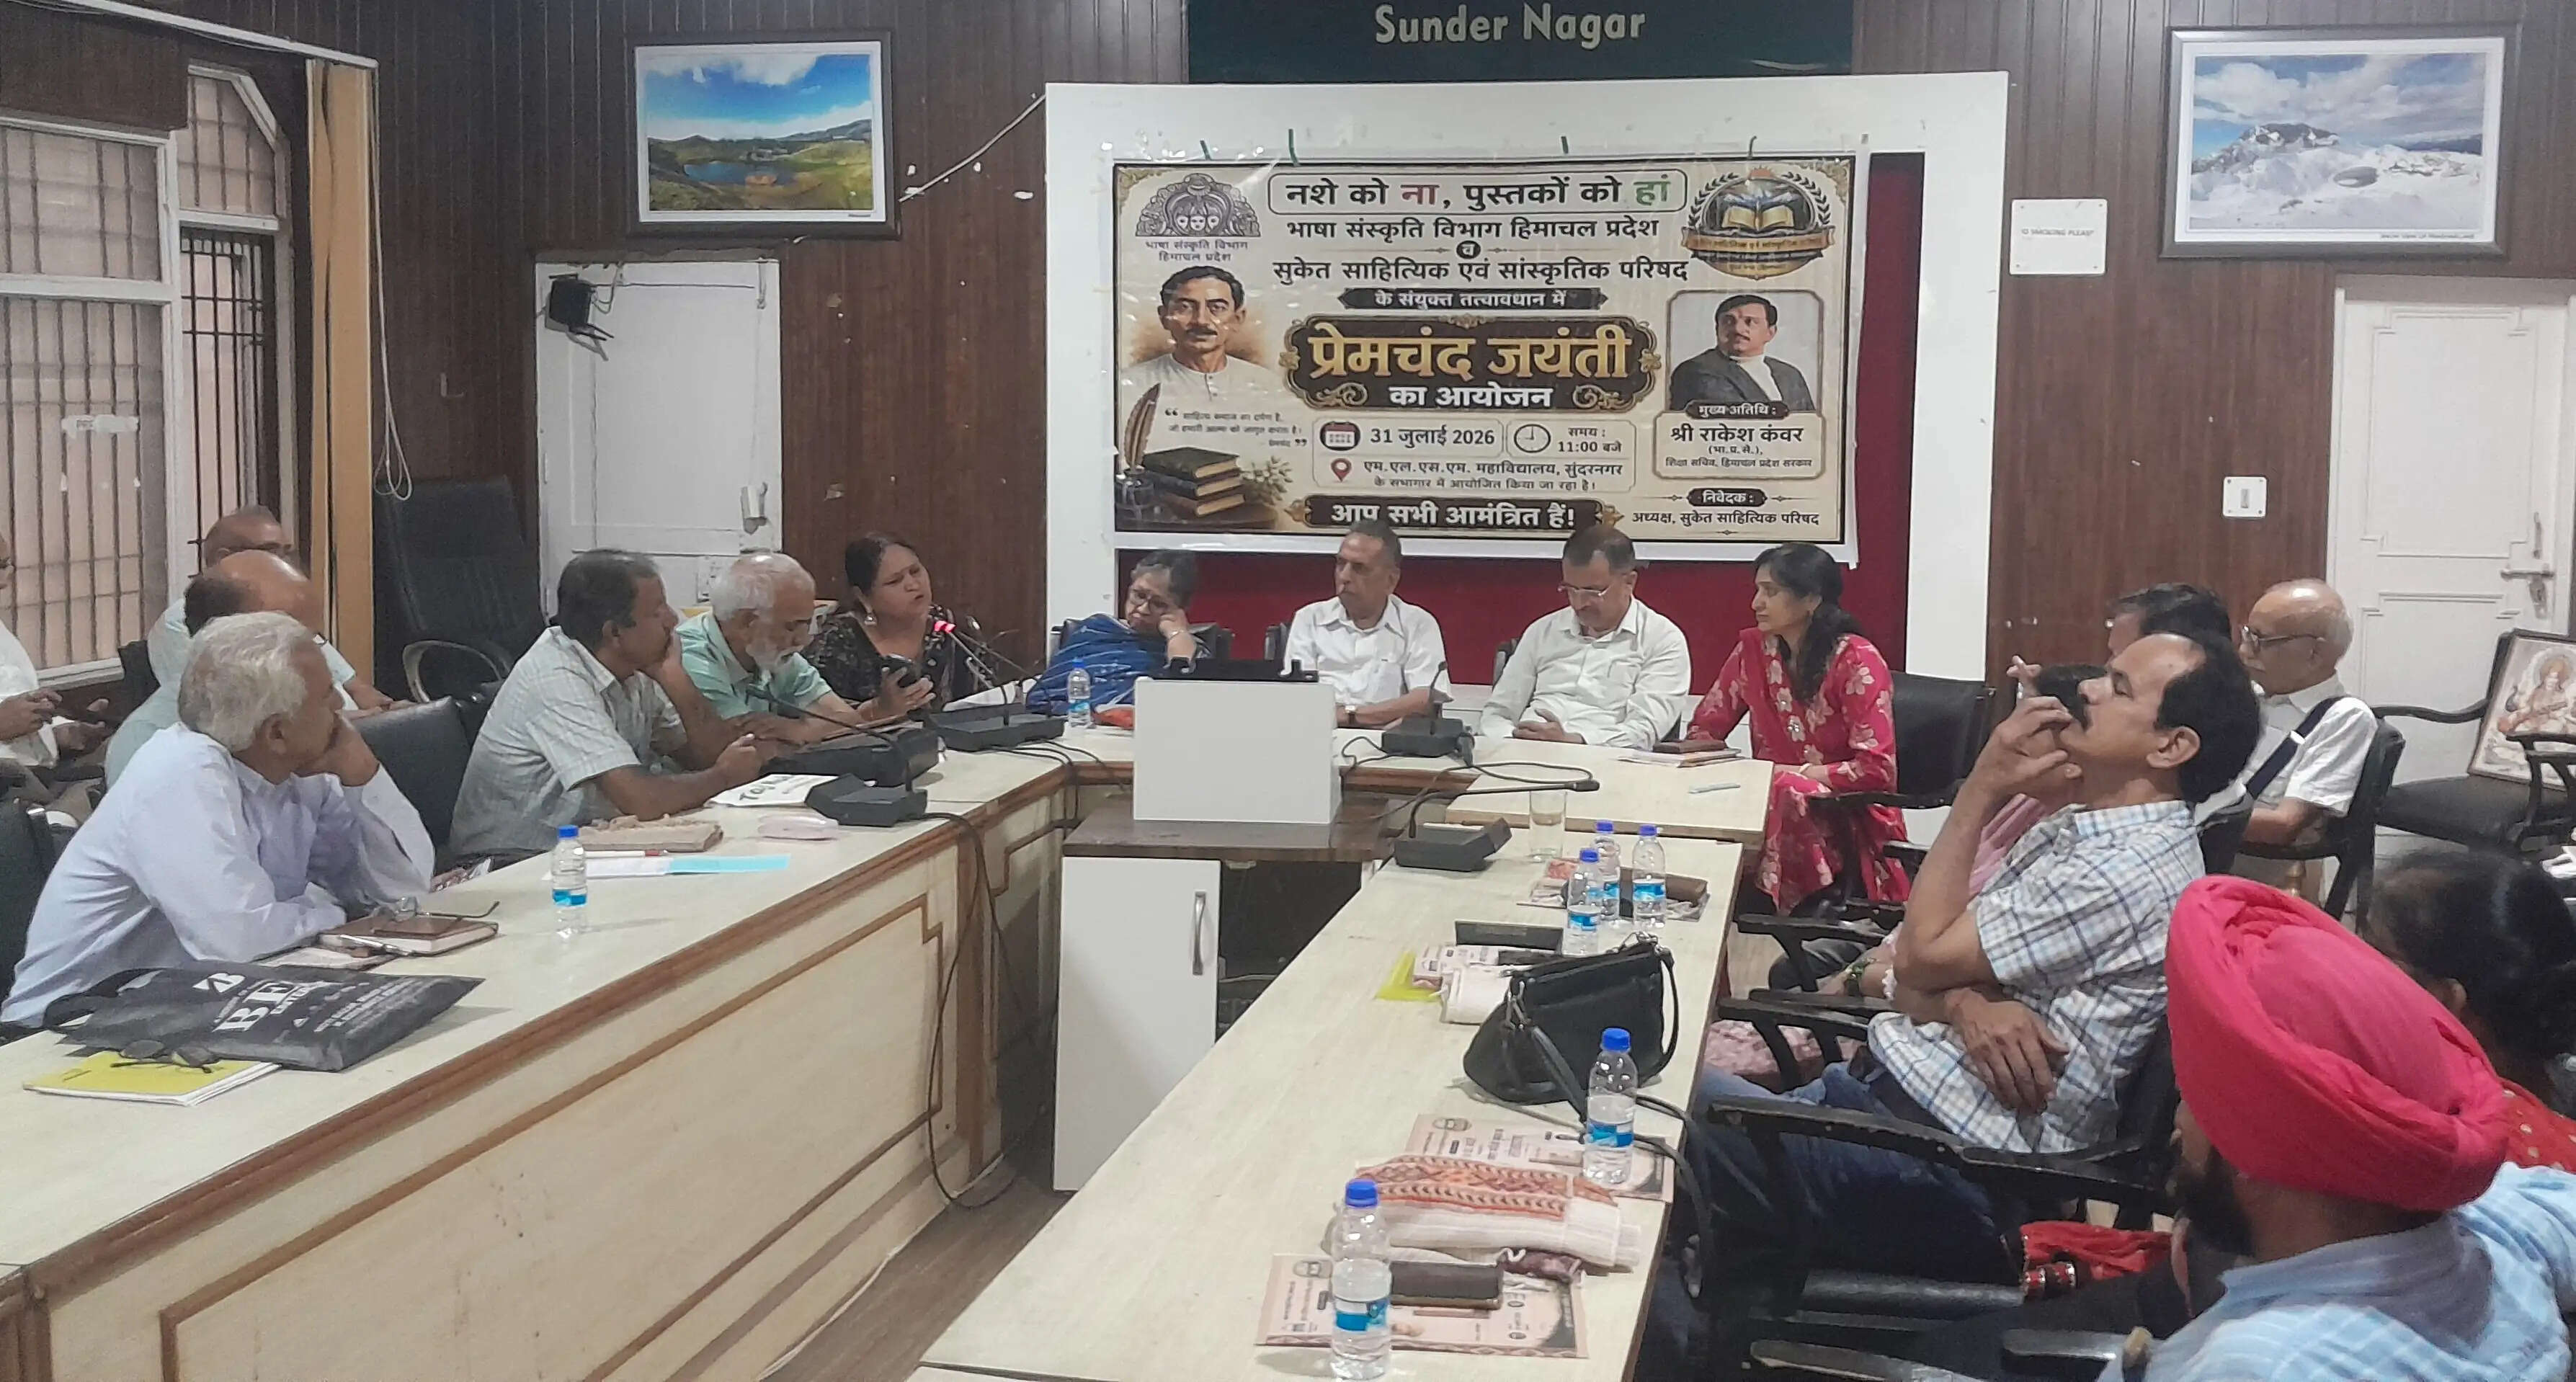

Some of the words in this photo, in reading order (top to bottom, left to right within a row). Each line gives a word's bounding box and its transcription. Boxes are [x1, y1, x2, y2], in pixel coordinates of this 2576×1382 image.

[1376, 4, 1509, 43] Sunder
[1523, 2, 1645, 49] Nagar
[1286, 179, 1339, 204] नशे
[1349, 179, 1389, 205] को
[1464, 177, 1569, 210] पुस्तकों
[1579, 178, 1622, 204] को
[1634, 174, 1671, 205] हां
[1287, 220, 1335, 238] भाषा
[1345, 216, 1424, 243] संस्कृति
[1433, 217, 1502, 238] विभाग
[1510, 217, 1596, 237] हिमाचल
[1606, 215, 1659, 236] प्रदेश
[1273, 257, 1330, 285] सुकेत
[1342, 257, 1448, 280] साहित्यिक
[1459, 257, 1489, 280] एवं
[1498, 257, 1610, 285] सांस्कृतिक
[1619, 257, 1688, 281] परिषद
[1374, 290, 1391, 307] के
[1398, 291, 1451, 311] संयुक्त
[1552, 290, 1566, 306] में
[1308, 322, 1476, 381] प्रेमचंद
[1487, 324, 1632, 378] जयंती
[1389, 386, 1425, 407] का
[1435, 381, 1554, 408] आयोजन
[1698, 405, 1726, 418] मुख्य
[1371, 428, 1393, 443] 31
[1398, 424, 1447, 448] जुलाई
[1452, 429, 1495, 445] 2026
[1670, 424, 1694, 442] श्री
[1699, 424, 1754, 442] राकेश
[1760, 424, 1804, 442] कंवर
[1558, 441, 1598, 453] 11:00
[1602, 440, 1623, 453] बजे
[1476, 460, 1560, 476] महाविद्यालय,
[1565, 461, 1623, 479] सुंदरनगर
[1450, 477, 1502, 490] आयोजित
[1506, 477, 1535, 490] किया
[1539, 480, 1554, 490] जा
[1558, 481, 1577, 491] रहा
[1701, 490, 1747, 504] निवेदक
[1332, 505, 1380, 522] आप
[1387, 501, 1439, 525] सभी
[1445, 502, 1541, 526] आमंत्रित
[1546, 503, 1575, 527] हैं!
[1631, 512, 1676, 525] अध्यक्ष,
[1679, 510, 1713, 528] सुकेत
[1716, 510, 1778, 524] साहित्यिक
[1781, 511, 1820, 526] परिषद
